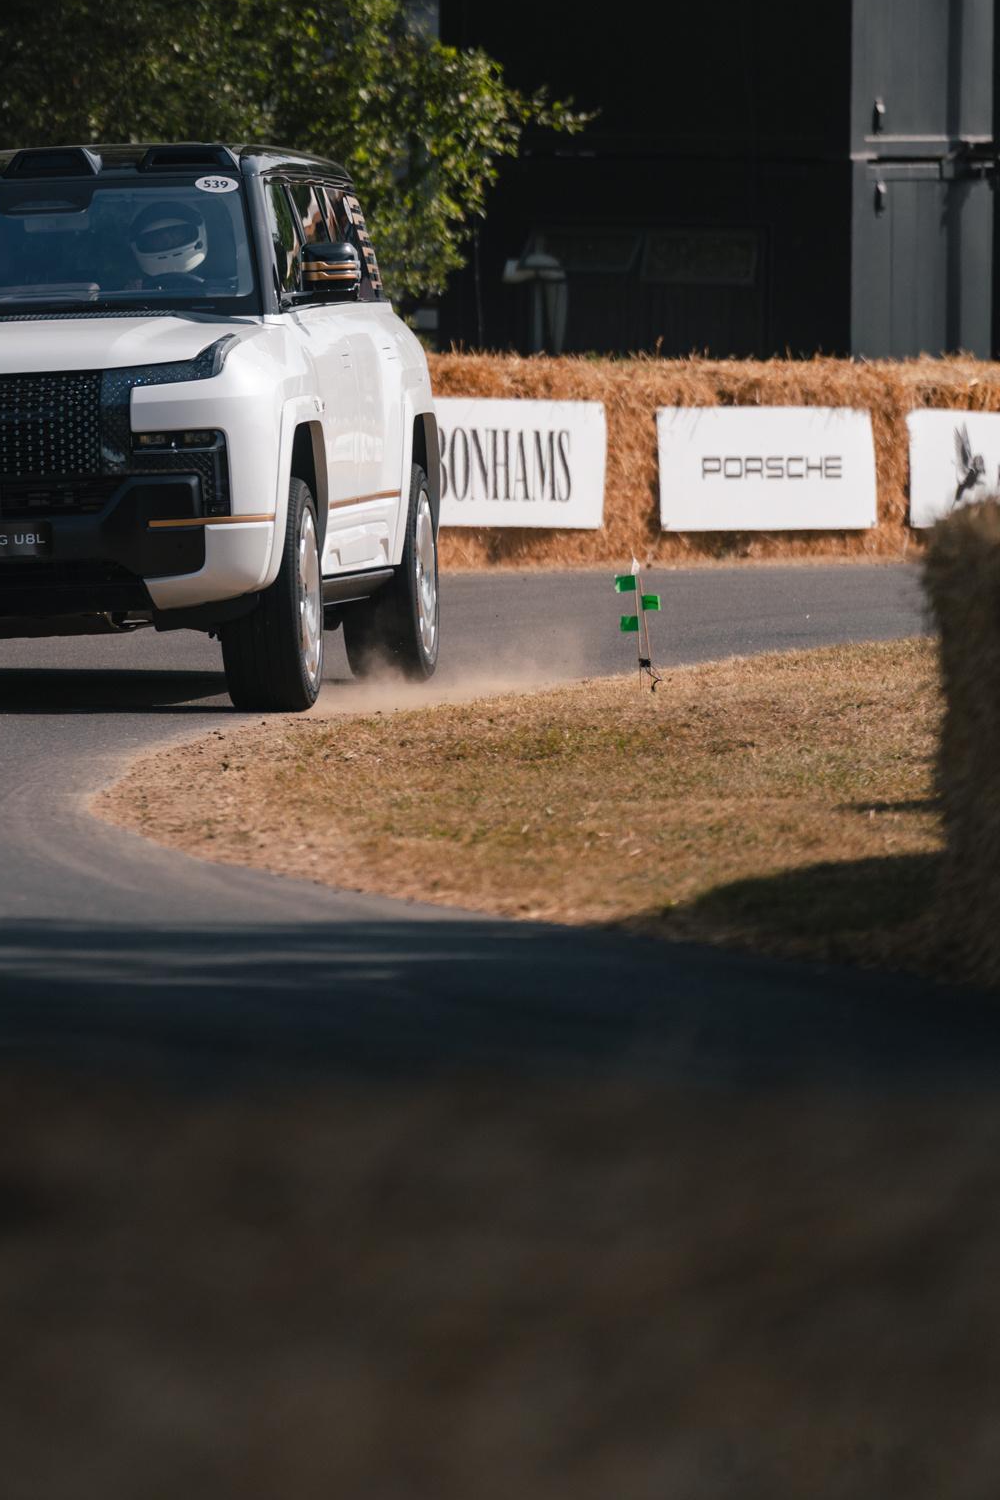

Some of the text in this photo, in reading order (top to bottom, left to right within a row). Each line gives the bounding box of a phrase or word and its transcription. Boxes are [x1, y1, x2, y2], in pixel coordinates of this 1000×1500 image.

[203, 180, 228, 188] 539
[702, 457, 842, 479] PORSCHE
[14, 533, 46, 545] U8L
